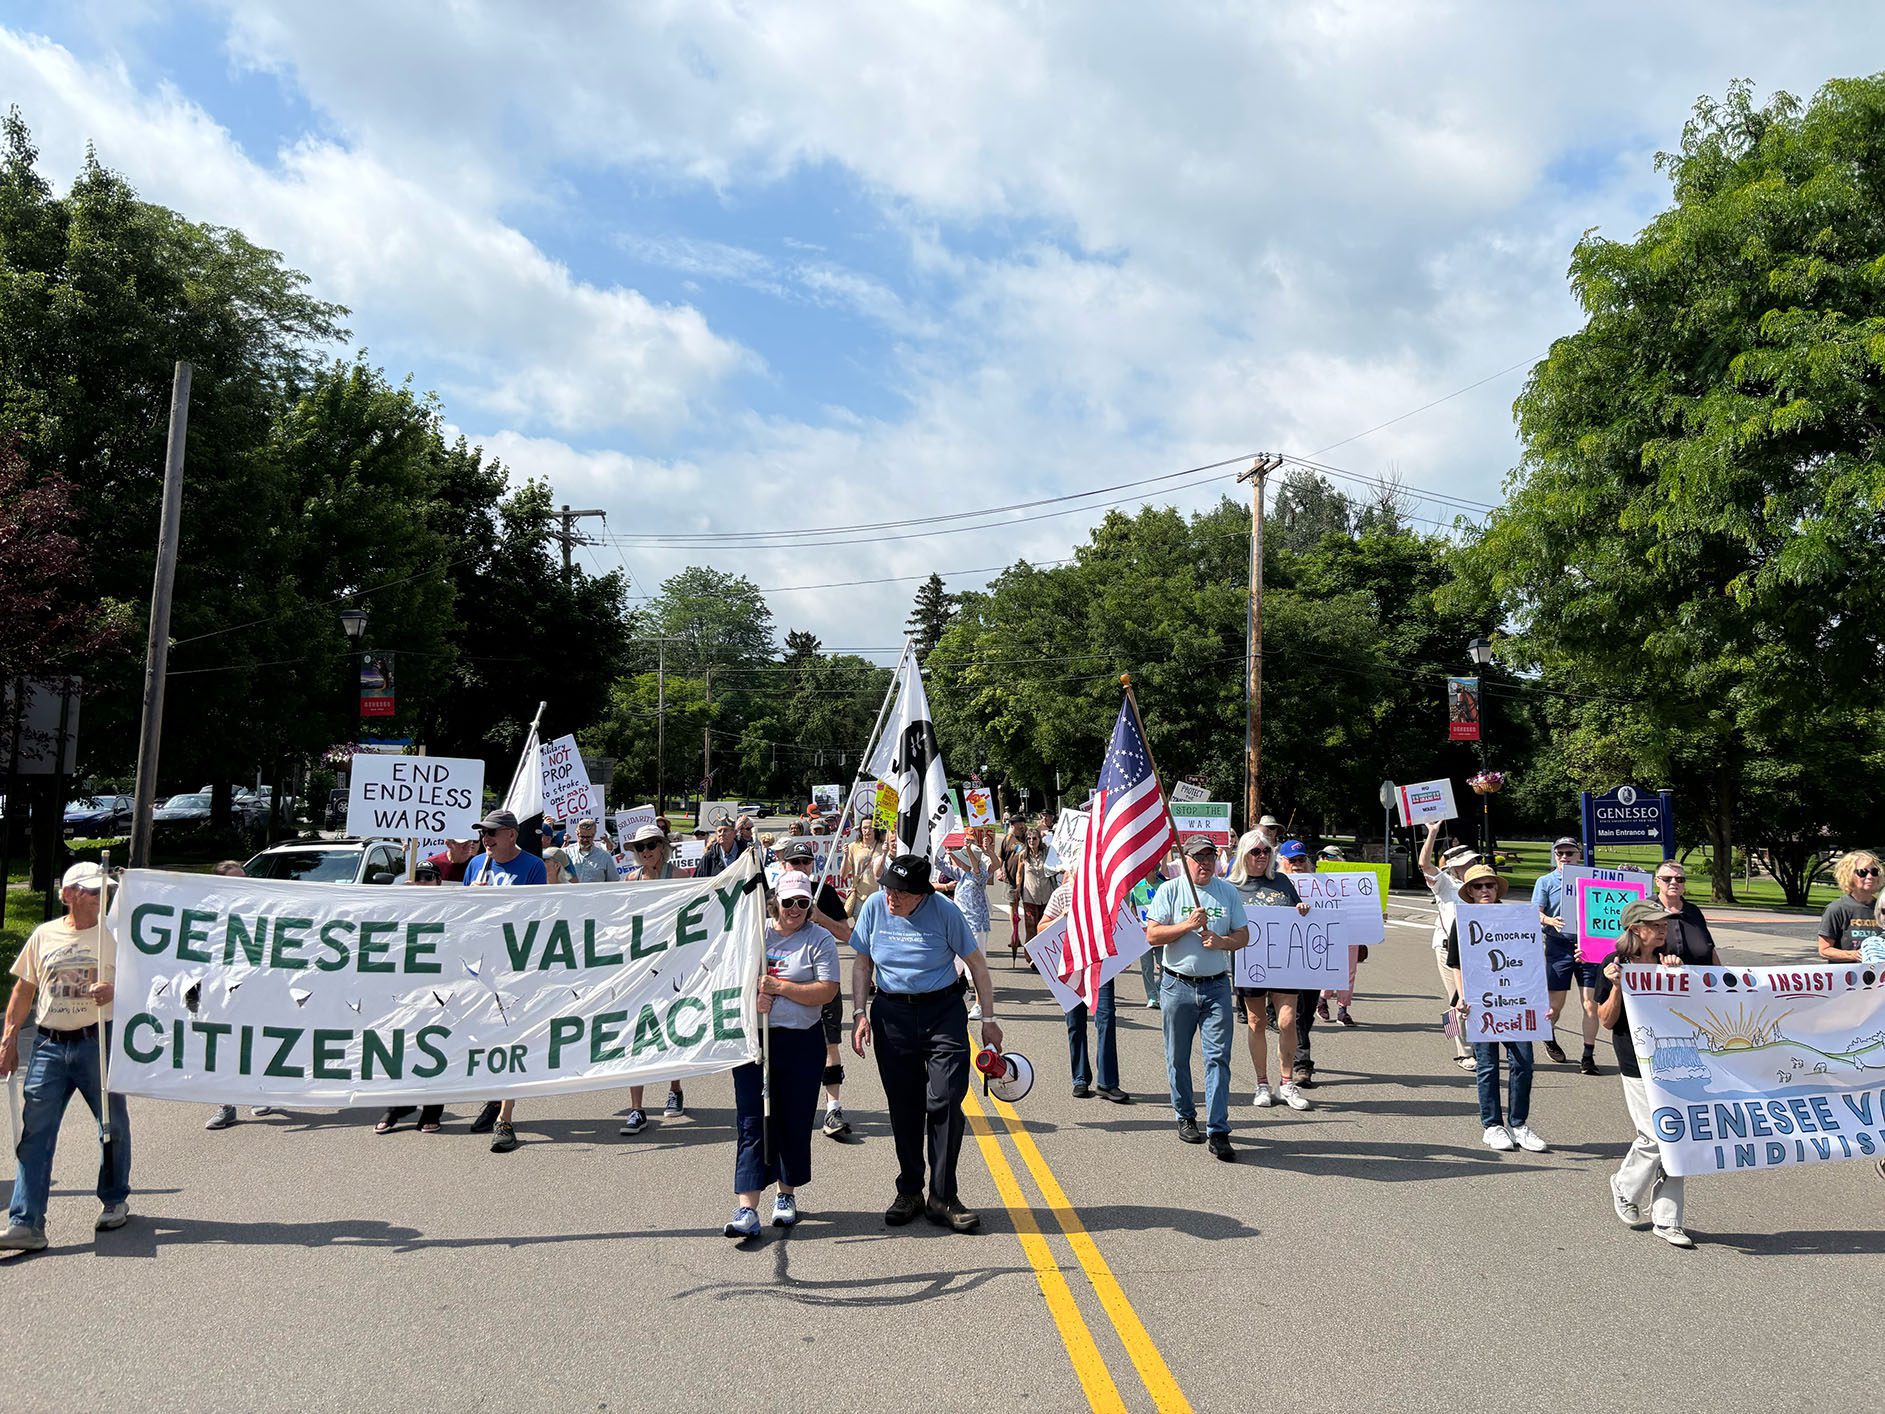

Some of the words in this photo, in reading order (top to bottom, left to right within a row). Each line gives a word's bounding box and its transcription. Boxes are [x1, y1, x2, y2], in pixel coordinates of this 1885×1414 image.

[549, 748, 571, 766] NOT
[393, 763, 449, 783] END
[543, 764, 572, 785] PROP
[364, 783, 471, 809] ENDLESS
[542, 791, 550, 799] to
[553, 780, 579, 794] stroke
[550, 795, 565, 805] one
[567, 784, 589, 798] man's
[556, 793, 588, 819] EGO
[1176, 807, 1197, 815] STOP
[1206, 806, 1223, 815] THE
[1597, 807, 1659, 819] GENESEO
[374, 810, 445, 832] WARS
[618, 815, 655, 830] SOLIDARITY
[1189, 820, 1211, 828] WAR
[1592, 869, 1624, 882] FUND
[1592, 892, 1628, 904] TAX
[1604, 906, 1621, 915] the
[130, 902, 445, 975] GENESEE
[502, 879, 748, 972] VALLEY
[1243, 920, 1340, 970] PEACE
[1488, 949, 1523, 972] Dies
[1499, 975, 1510, 987] in
[1625, 972, 1690, 992] UNITE
[1768, 972, 1834, 992] INSIST
[1482, 992, 1527, 1008] Silence
[123, 1012, 449, 1080] CITIZENS
[467, 1045, 527, 1076] FOR
[549, 987, 746, 1069] PEACE
[1652, 1096, 1840, 1143] GENESEE
